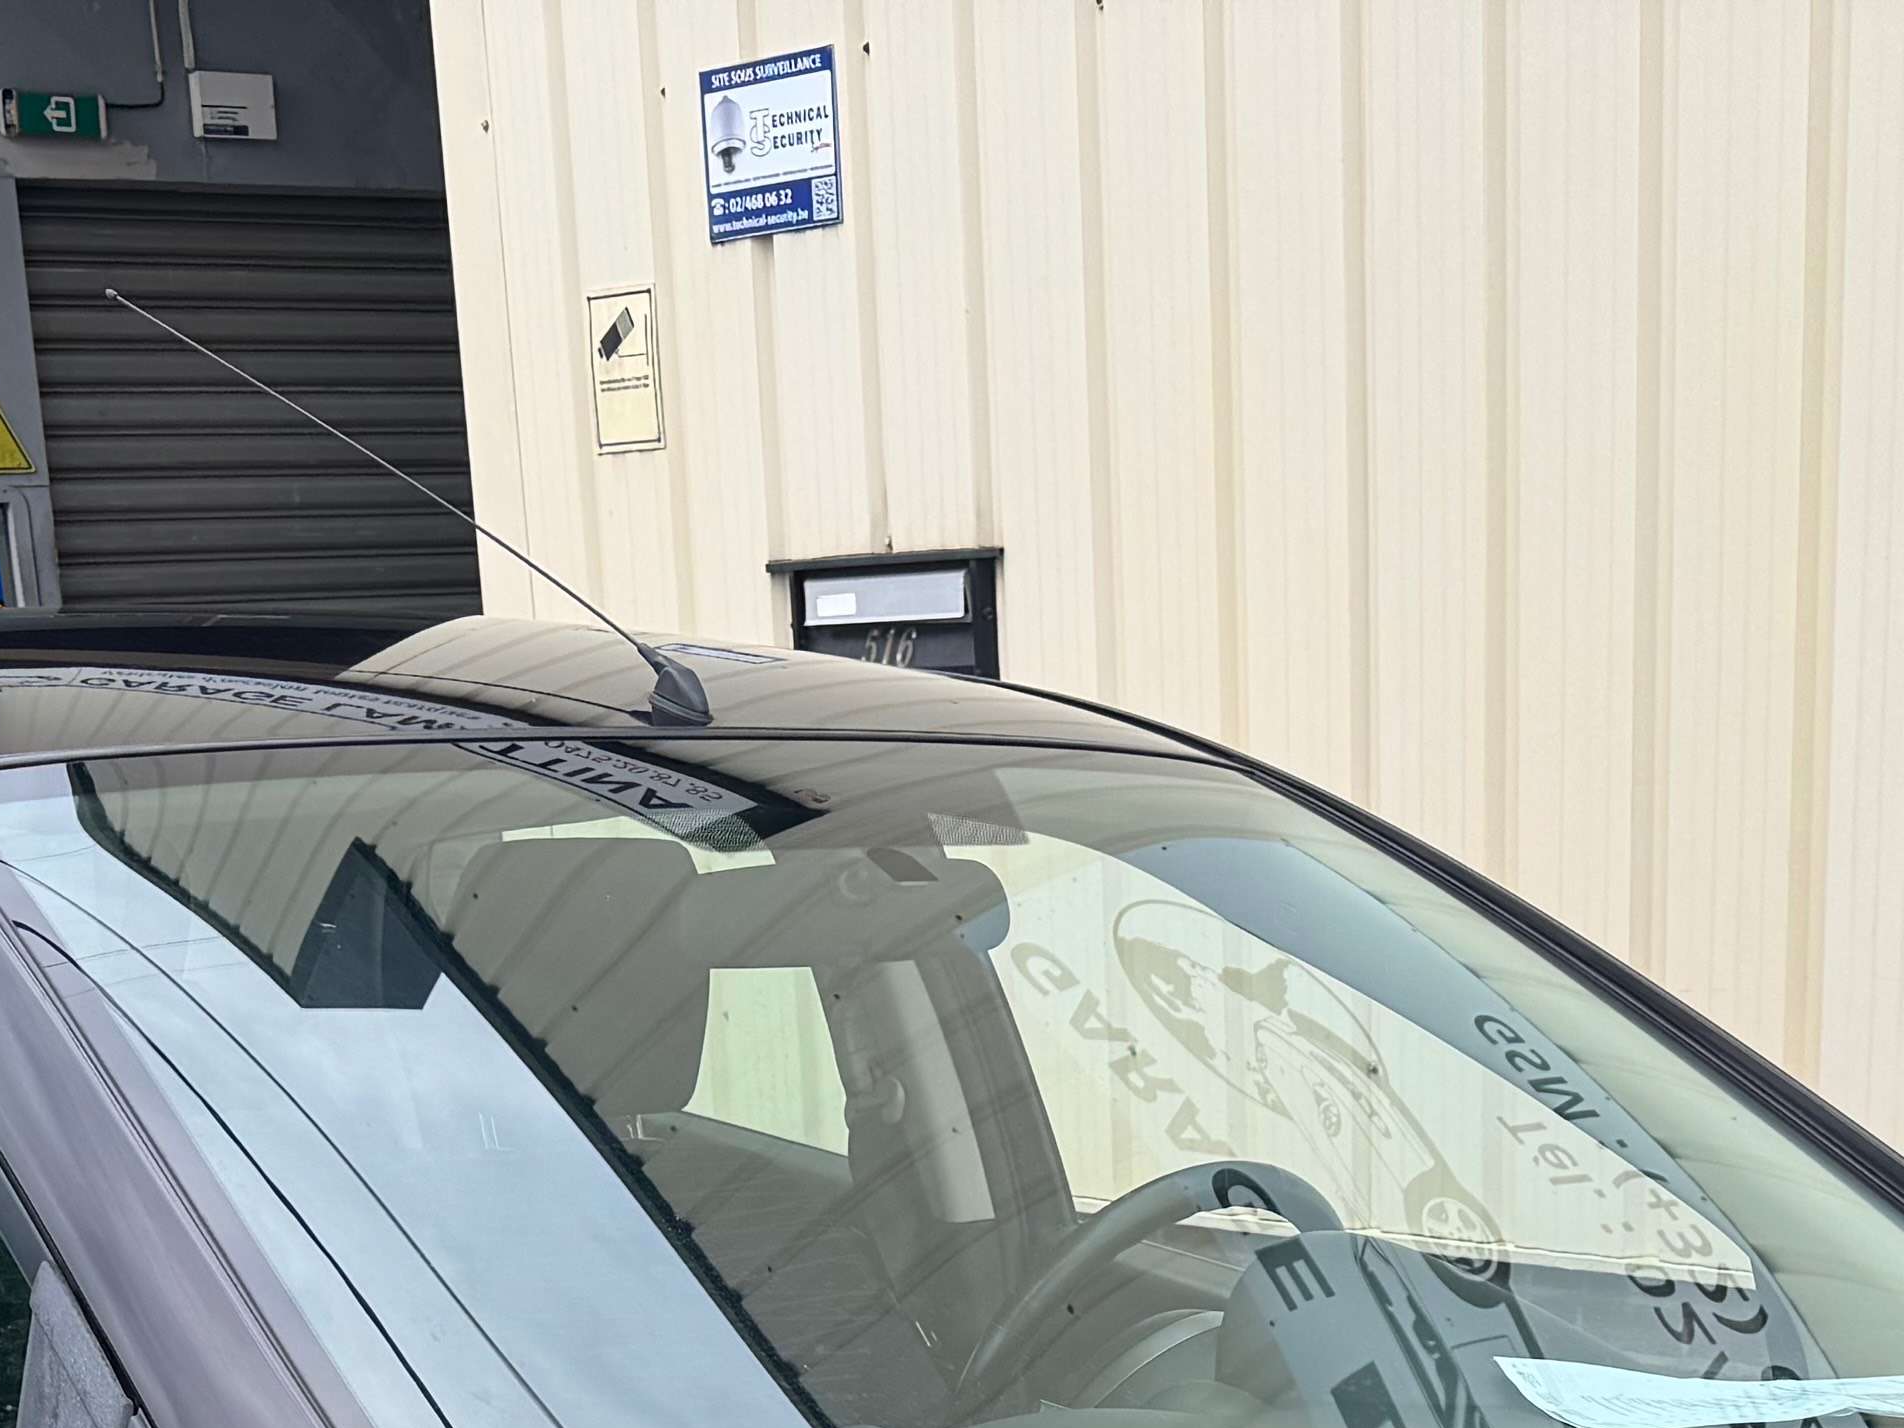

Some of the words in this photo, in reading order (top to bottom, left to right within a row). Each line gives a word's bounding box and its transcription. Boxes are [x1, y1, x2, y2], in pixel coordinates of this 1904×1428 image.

[711, 72, 729, 88] SITE
[731, 68, 755, 85] SOUS
[755, 53, 822, 80] SURVEILLANCE
[765, 191, 780, 207] 06
[779, 188, 793, 204] 32
[712, 208, 809, 234] www.technical-security.be
[861, 627, 917, 668] 516
